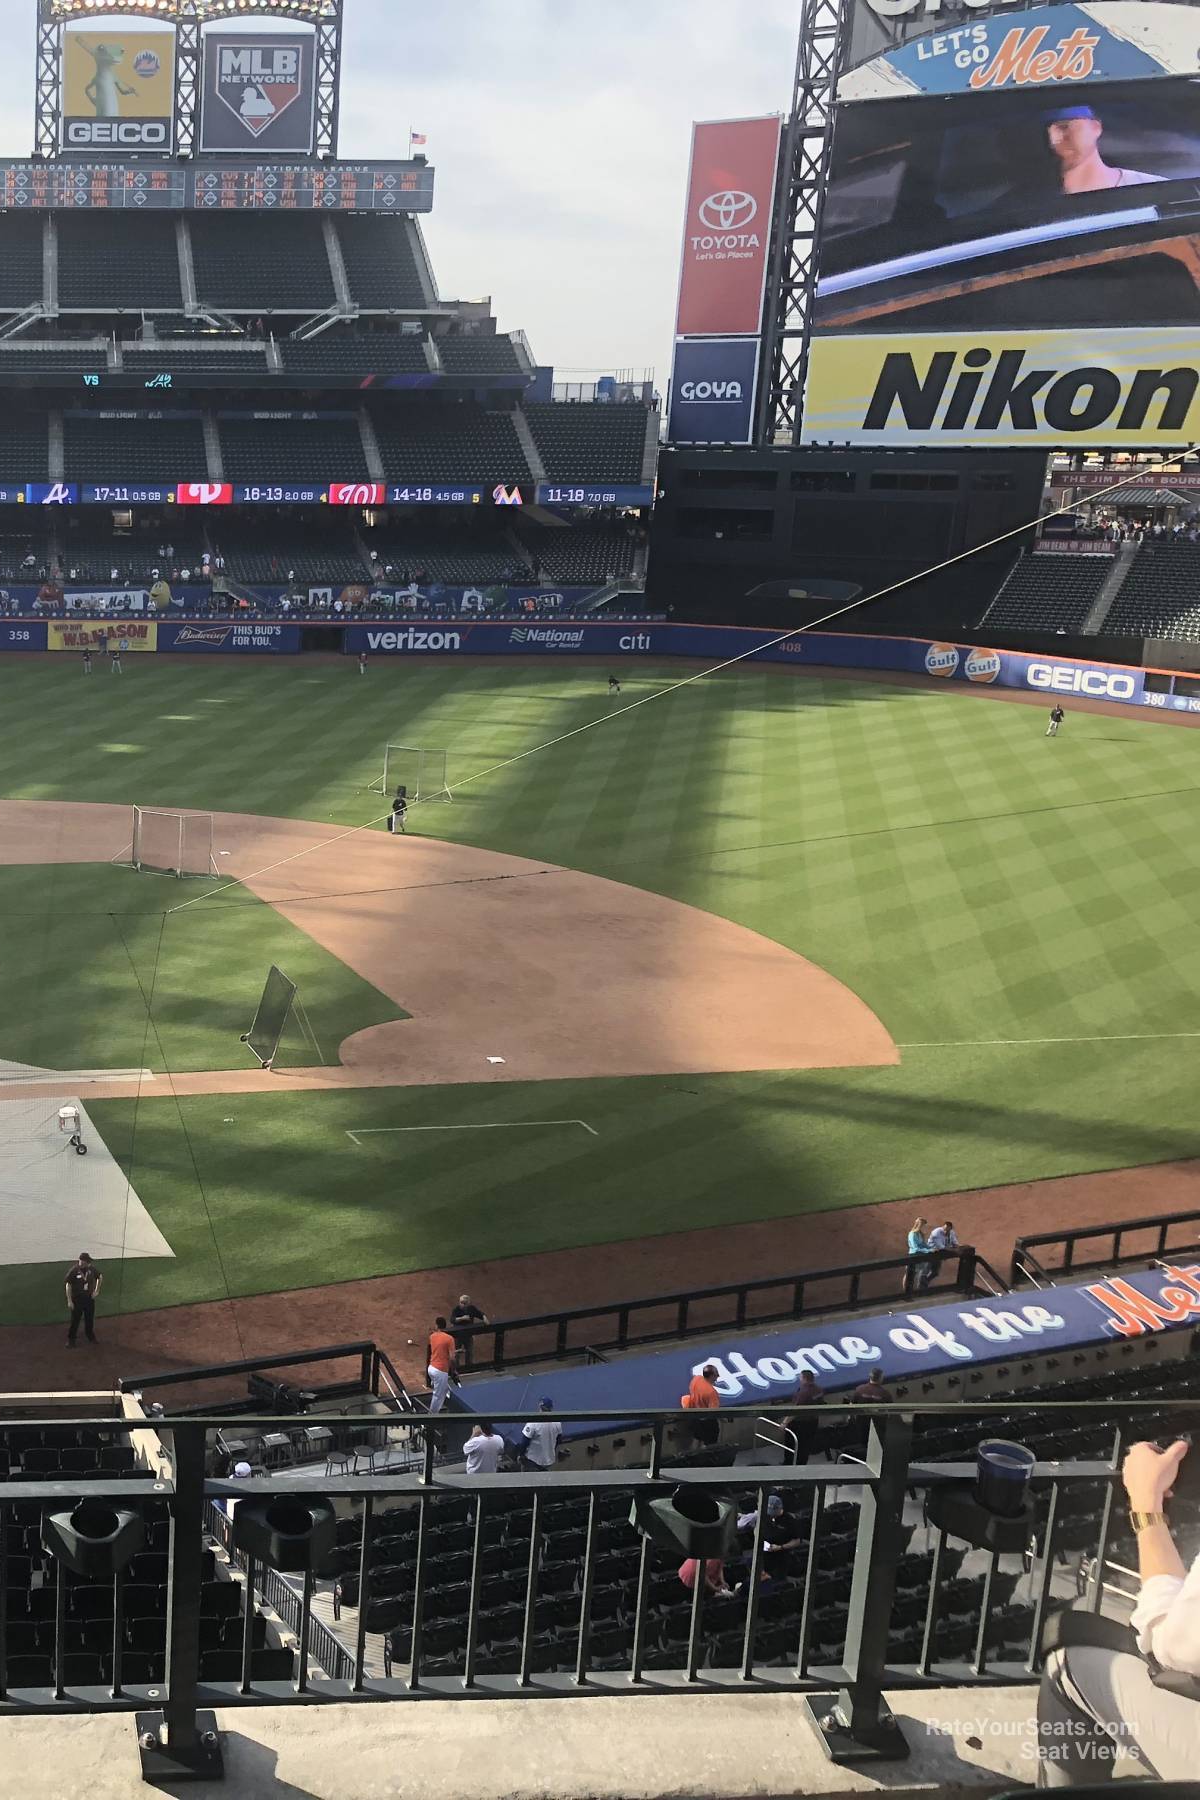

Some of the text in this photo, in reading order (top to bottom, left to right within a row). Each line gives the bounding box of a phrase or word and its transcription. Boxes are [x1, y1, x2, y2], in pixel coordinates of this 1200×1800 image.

[917, 24, 988, 61] LET'S
[221, 48, 297, 75] MLB
[954, 47, 990, 68] GO
[969, 25, 1100, 90] Mets
[221, 75, 296, 84] NETWORK
[68, 122, 166, 143] GEICO
[691, 234, 760, 250] TOYOTA
[696, 251, 753, 260] Let's Go Places
[84, 375, 99, 386] VS
[680, 381, 743, 401] GOYA
[861, 347, 1200, 432] Nikon
[1062, 475, 1087, 483] THE
[1091, 475, 1112, 483] JIM
[17, 492, 24, 502] 2
[94, 488, 161, 501] 17-11 0.5 GB
[167, 493, 174, 502] 3
[243, 488, 313, 500] 16-13 2.0 GB
[320, 493, 327, 502] 4
[393, 489, 464, 501] 14-18 4.5 GB
[472, 493, 480, 503] 5
[548, 489, 615, 501] 11-18 7.0 GB
[1080, 541, 1111, 551] JIM BEAM
[8, 631, 30, 641] 358
[181, 630, 226, 640] Budweiser
[233, 626, 281, 635] THIS BUD'S
[527, 629, 585, 641] National
[232, 636, 272, 646] FOR YOU.
[368, 627, 460, 650] verizon
[619, 633, 650, 650] citi
[779, 642, 801, 653] 408
[927, 653, 956, 667] Gulf
[967, 659, 998, 673] Gulf
[1027, 663, 1135, 699] GEICO
[1143, 692, 1166, 706] 380
[693, 1330, 882, 1398] Home
[888, 1313, 974, 1360] of
[959, 1304, 1066, 1344] the
